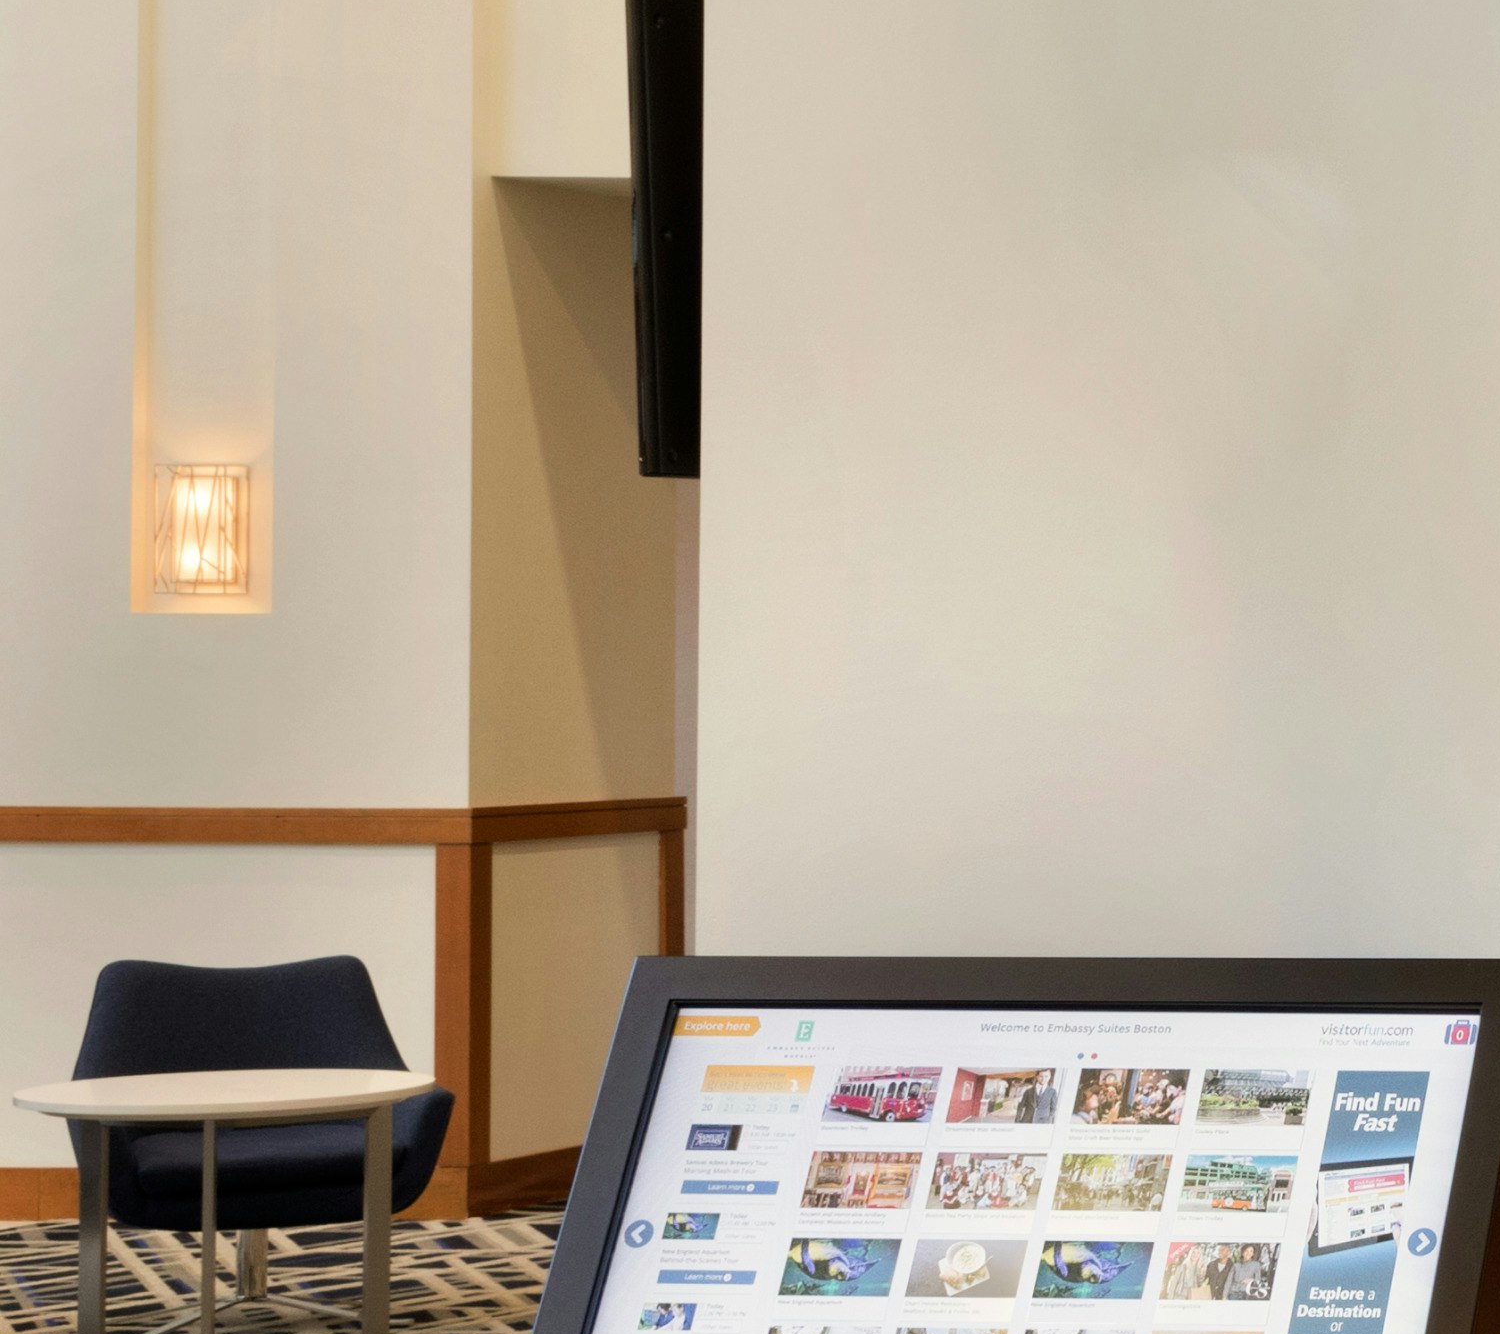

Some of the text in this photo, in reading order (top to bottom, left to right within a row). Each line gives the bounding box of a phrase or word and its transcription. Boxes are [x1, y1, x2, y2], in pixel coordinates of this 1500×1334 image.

[684, 1021, 751, 1033] Explore here
[980, 1023, 1172, 1035] Welcome to Embassy Suites Boston
[1321, 1023, 1414, 1037] visitorfun.com
[1334, 1092, 1421, 1112] Find Fun
[1353, 1113, 1399, 1132] Fast
[707, 1183, 726, 1191] Learn
[684, 1273, 704, 1281] Learn
[1309, 1286, 1376, 1303] Explore a
[1296, 1304, 1381, 1318] Destination
[1329, 1321, 1344, 1332] or
